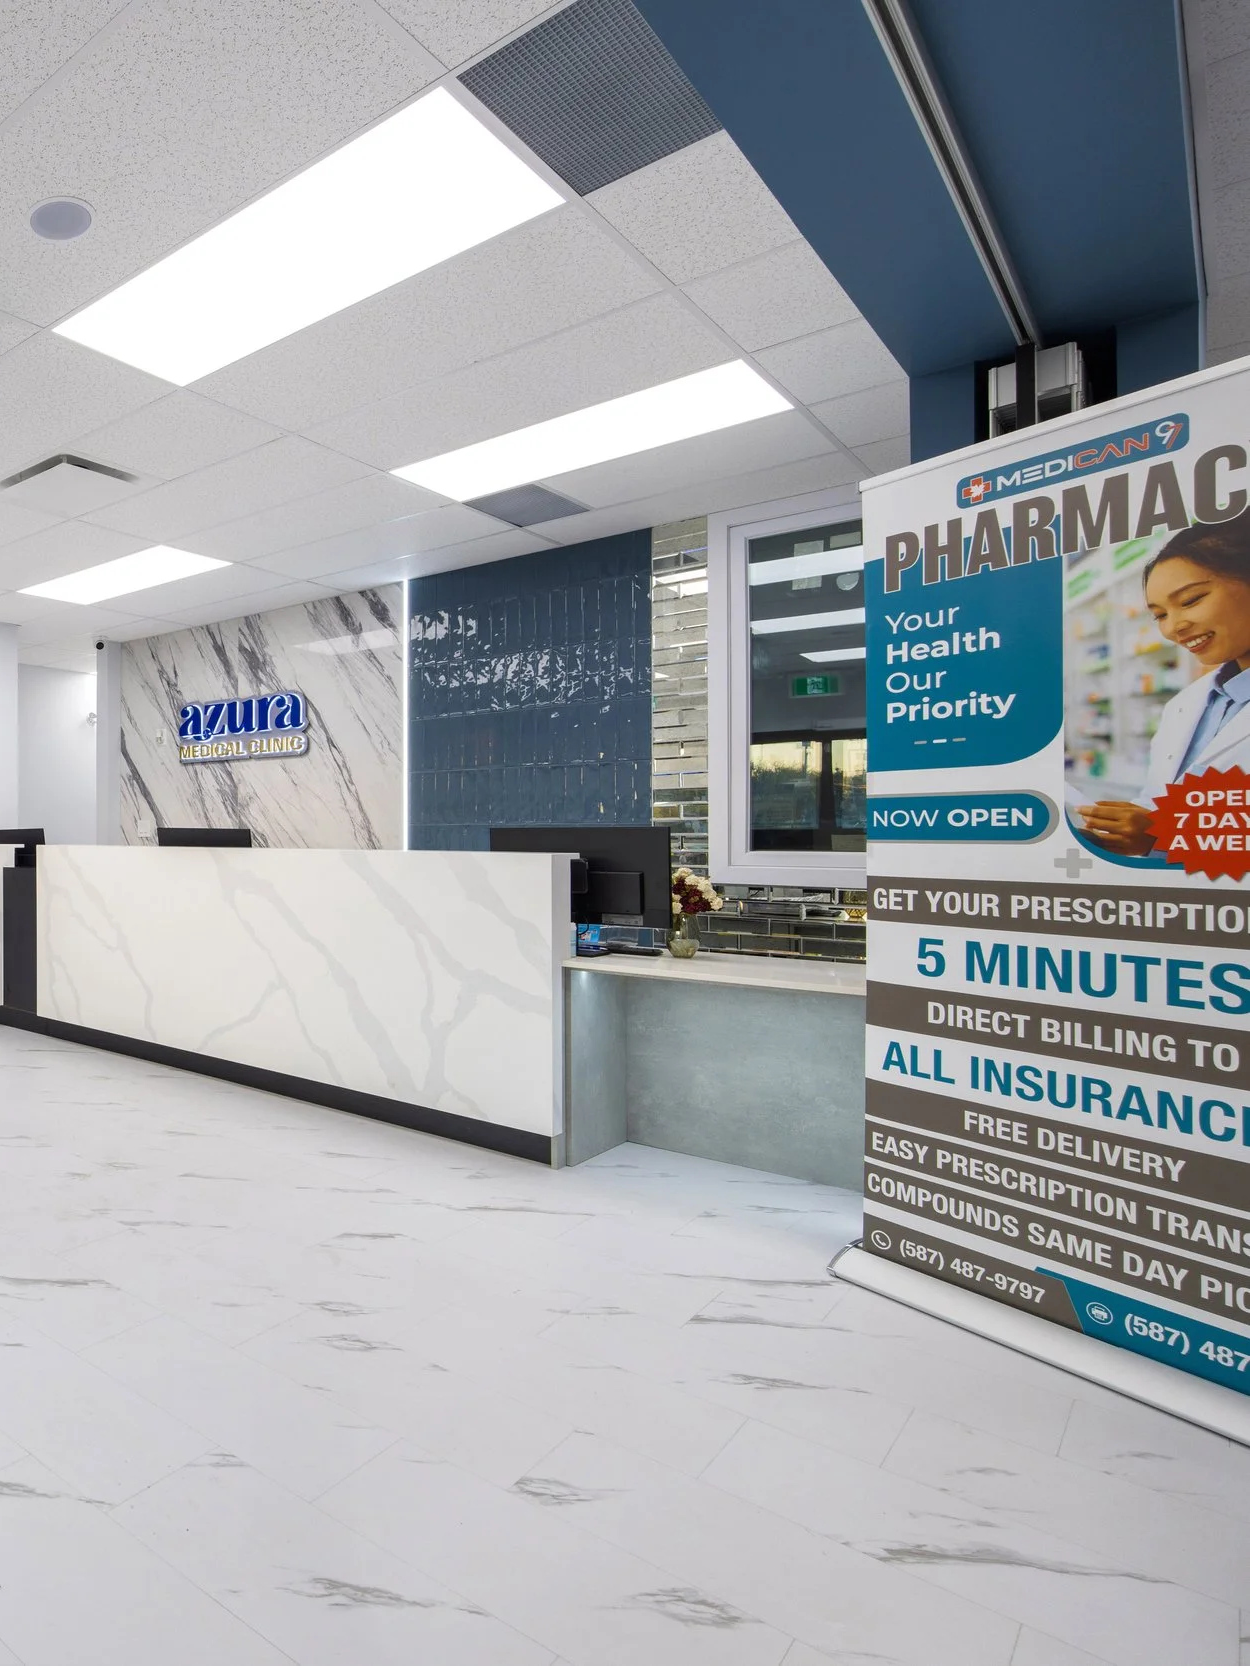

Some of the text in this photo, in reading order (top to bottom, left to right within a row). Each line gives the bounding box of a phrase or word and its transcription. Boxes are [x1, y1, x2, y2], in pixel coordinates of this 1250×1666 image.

[996, 432, 1150, 492] MEDICAN
[884, 606, 960, 635] Your
[886, 627, 1001, 664] Health
[885, 670, 947, 694] Our
[179, 693, 305, 741] azura
[886, 691, 1016, 724] Priority
[179, 736, 305, 759] MEDICAL CLINIC
[873, 807, 1034, 828] NOW OPEN
[1174, 813, 1190, 829] 7
[1185, 789, 1250, 807] OPE
[1169, 834, 1189, 851] A
[873, 887, 1250, 935] GET YOUR PRESCRIPTIO
[916, 937, 1250, 1015] 5 MINUTES
[927, 1001, 1240, 1073] DIRECT BILLING TO
[882, 1040, 956, 1085] ALL
[964, 1110, 1186, 1183] FREE DELIVERY
[872, 1132, 929, 1164] EASY
[936, 1150, 1138, 1225] PRESCRIPTION
[867, 1172, 1020, 1239] COMPOUNDS
[1027, 1222, 1113, 1269] SAME
[1123, 1251, 1189, 1291] DAY
[899, 1238, 1046, 1304] (587) 487-9797
[1124, 1313, 1250, 1372] (587) 487
